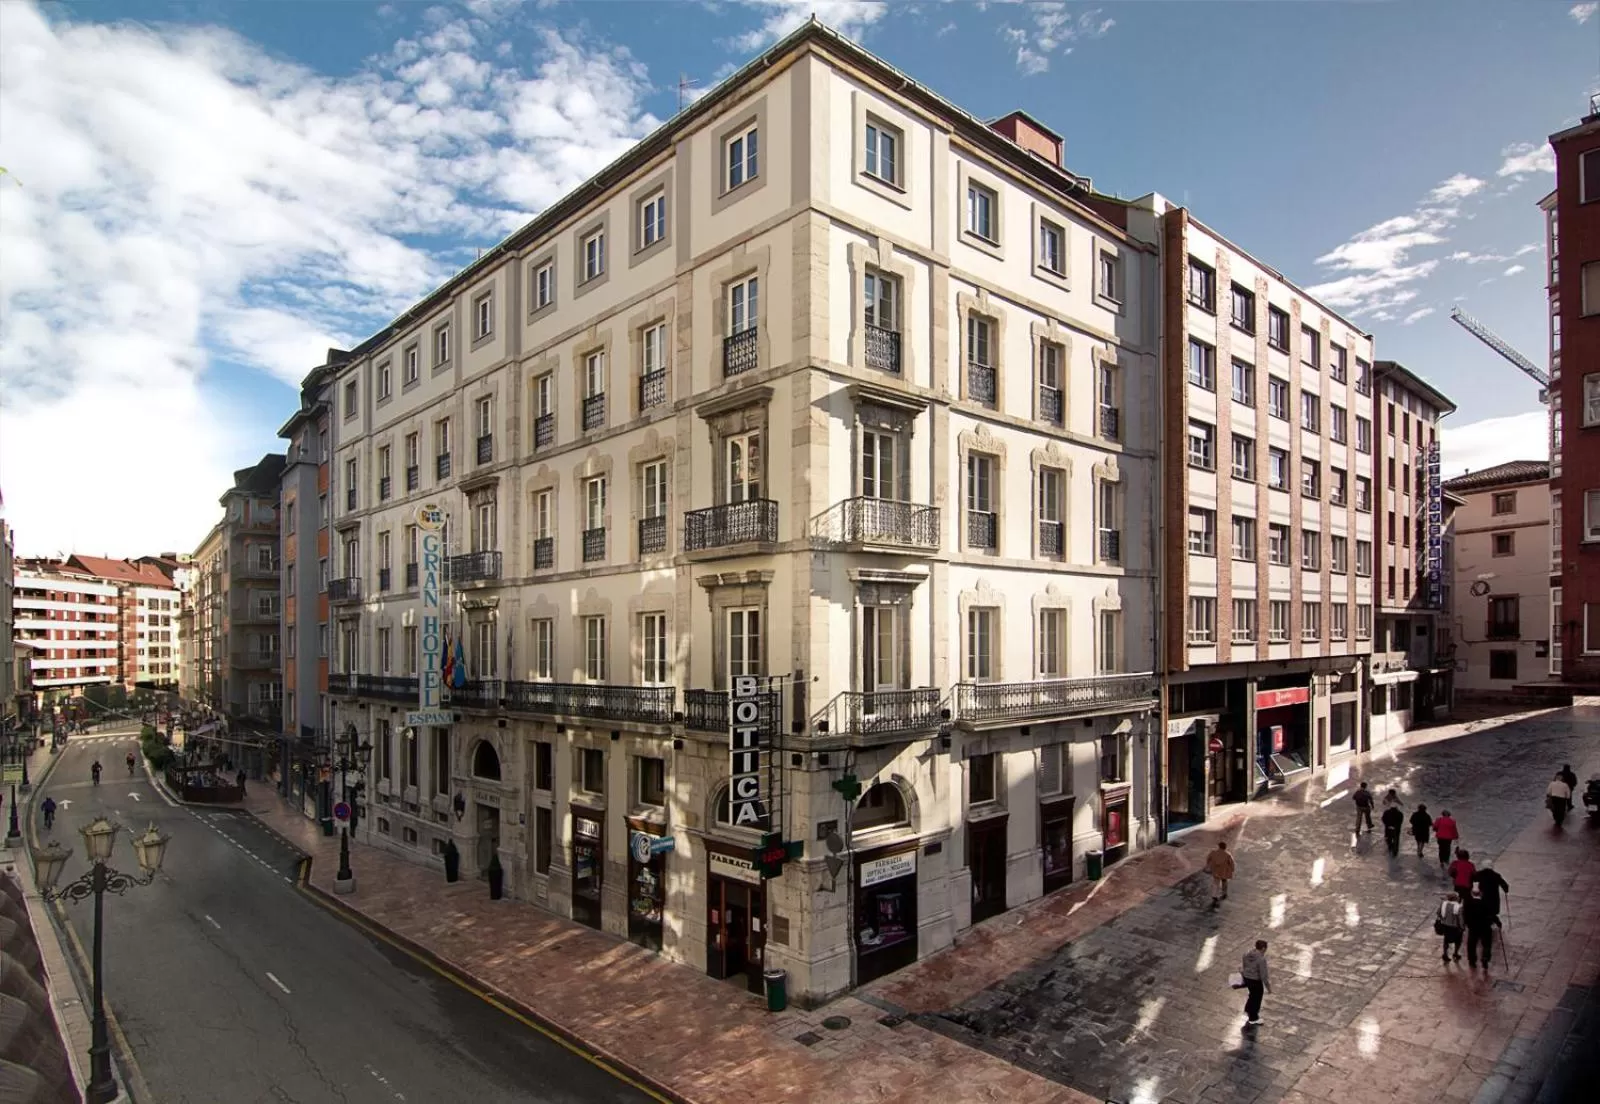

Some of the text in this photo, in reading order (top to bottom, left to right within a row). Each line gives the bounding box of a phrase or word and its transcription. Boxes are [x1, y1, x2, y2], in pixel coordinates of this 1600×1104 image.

[423, 534, 439, 708] GRAN HOTEL
[735, 676, 758, 825] BOTICA
[711, 854, 752, 870] FARMACI
